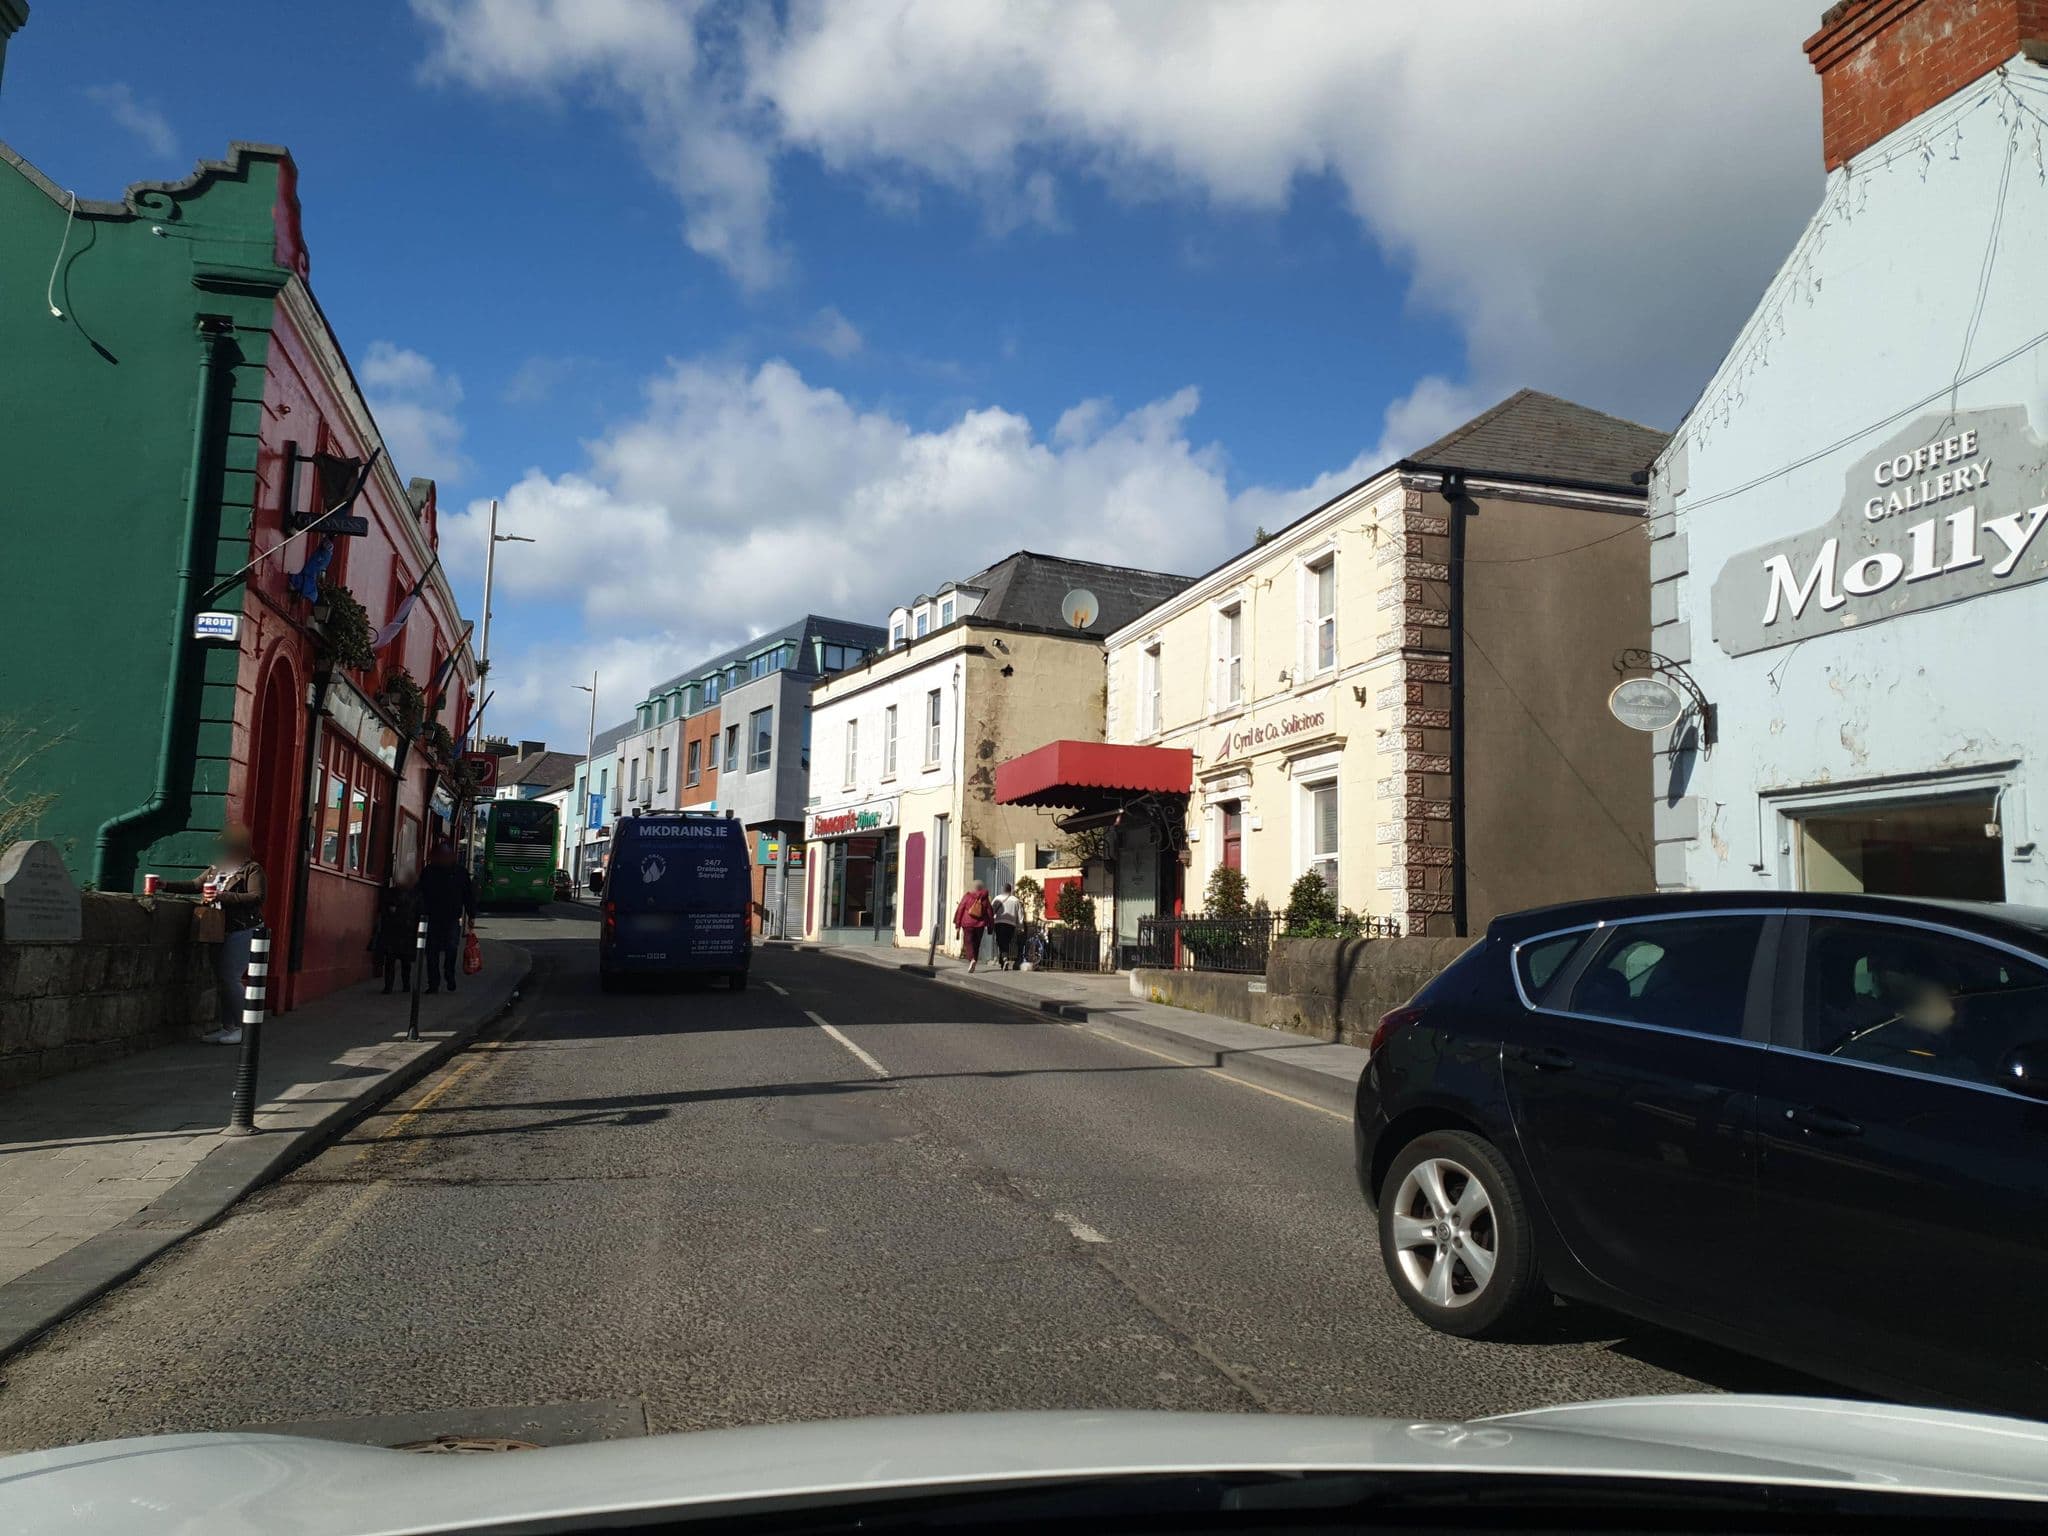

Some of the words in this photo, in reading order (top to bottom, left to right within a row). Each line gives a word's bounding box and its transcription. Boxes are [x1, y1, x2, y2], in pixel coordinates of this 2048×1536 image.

[1874, 429, 1978, 486] COFFEE
[1863, 457, 1992, 521] GALLERY
[1762, 504, 2048, 626] Molly
[1233, 727, 1254, 753] Cyril
[1254, 728, 1264, 744] &
[1281, 712, 1325, 737] Solicitors
[640, 825, 728, 837] MKDRAINS.IE
